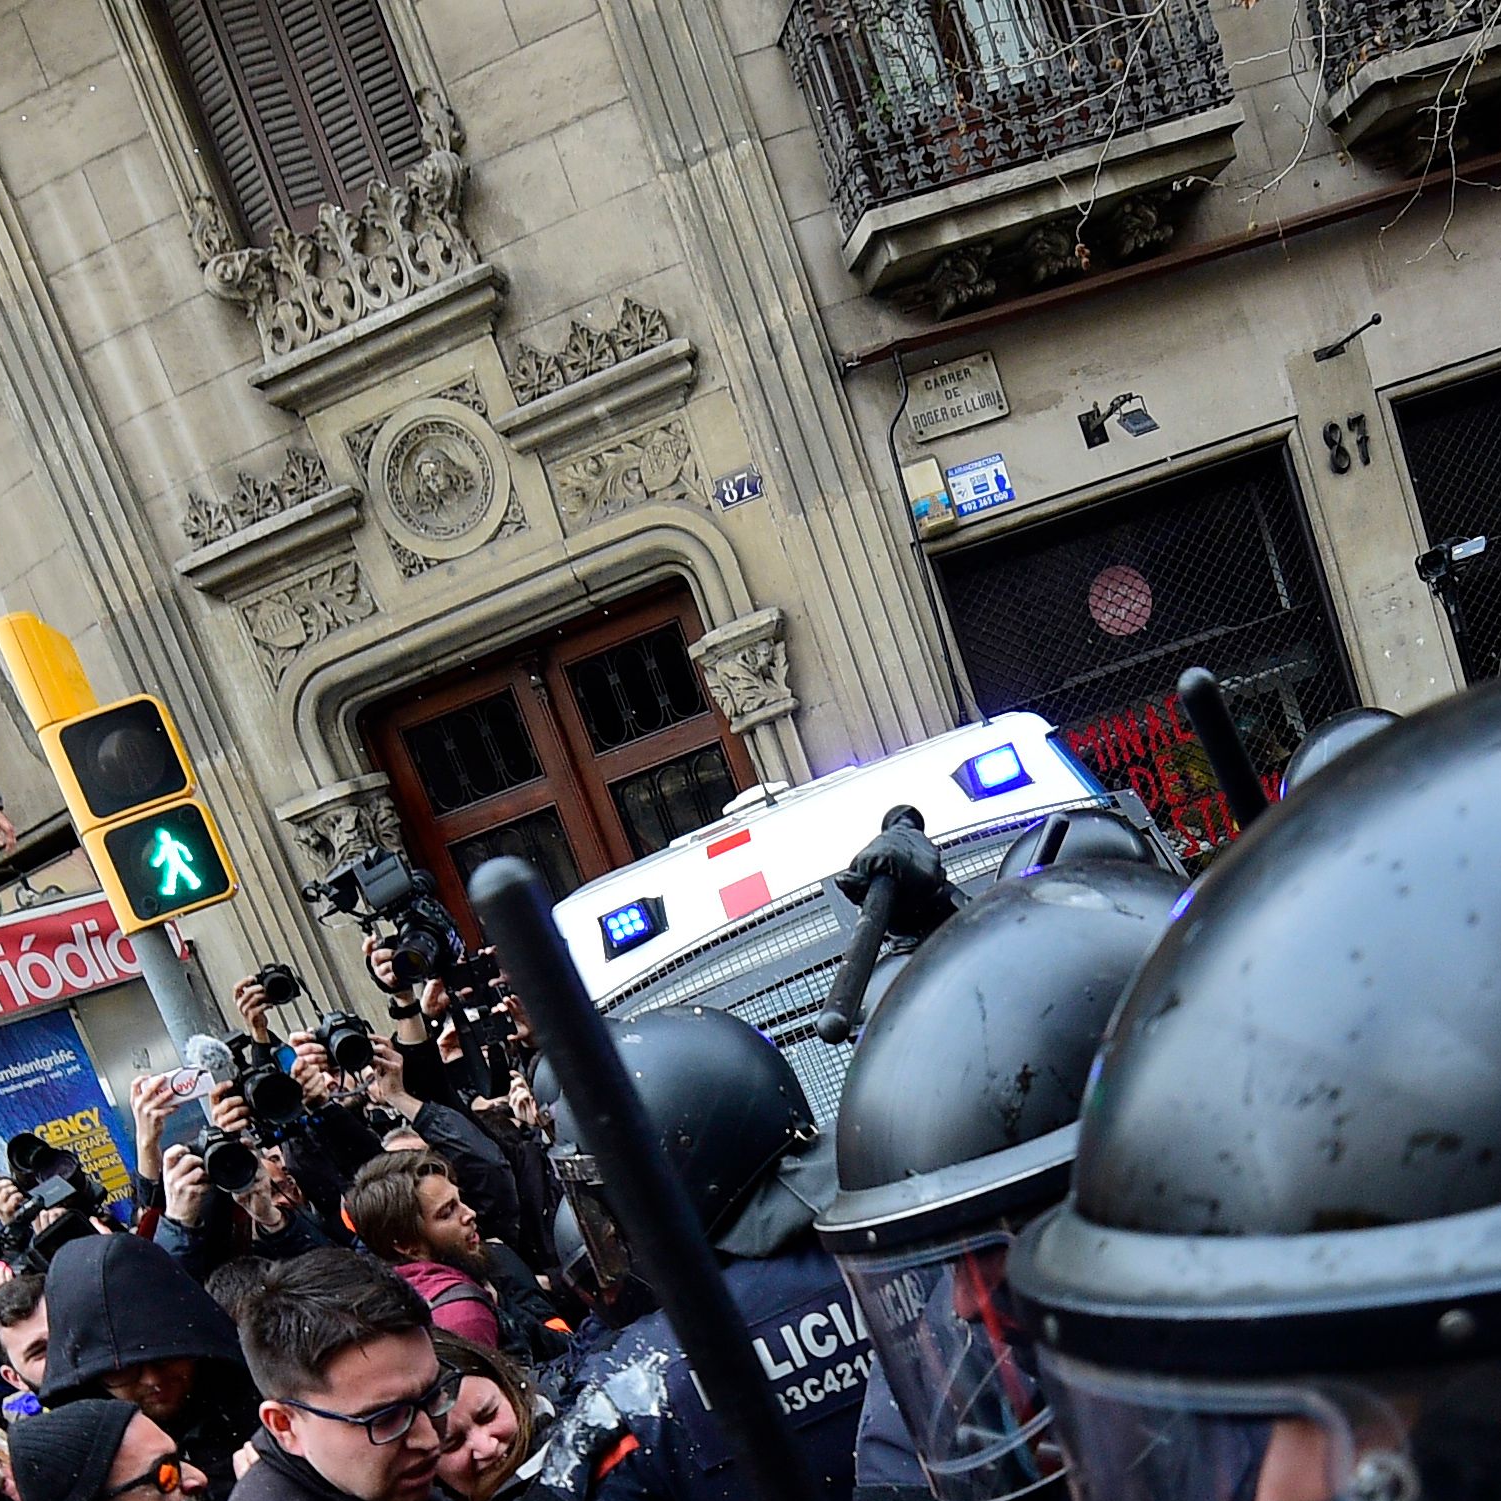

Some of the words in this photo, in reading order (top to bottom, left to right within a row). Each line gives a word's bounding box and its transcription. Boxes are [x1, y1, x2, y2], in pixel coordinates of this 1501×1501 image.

[924, 367, 972, 391] CARRER
[944, 387, 961, 400] DE
[912, 406, 949, 430] ROGER
[950, 404, 964, 418] DE
[1322, 413, 1371, 475] 87
[721, 472, 753, 503] 87
[1128, 753, 1187, 812] DE
[27, 1106, 101, 1143] GENCY
